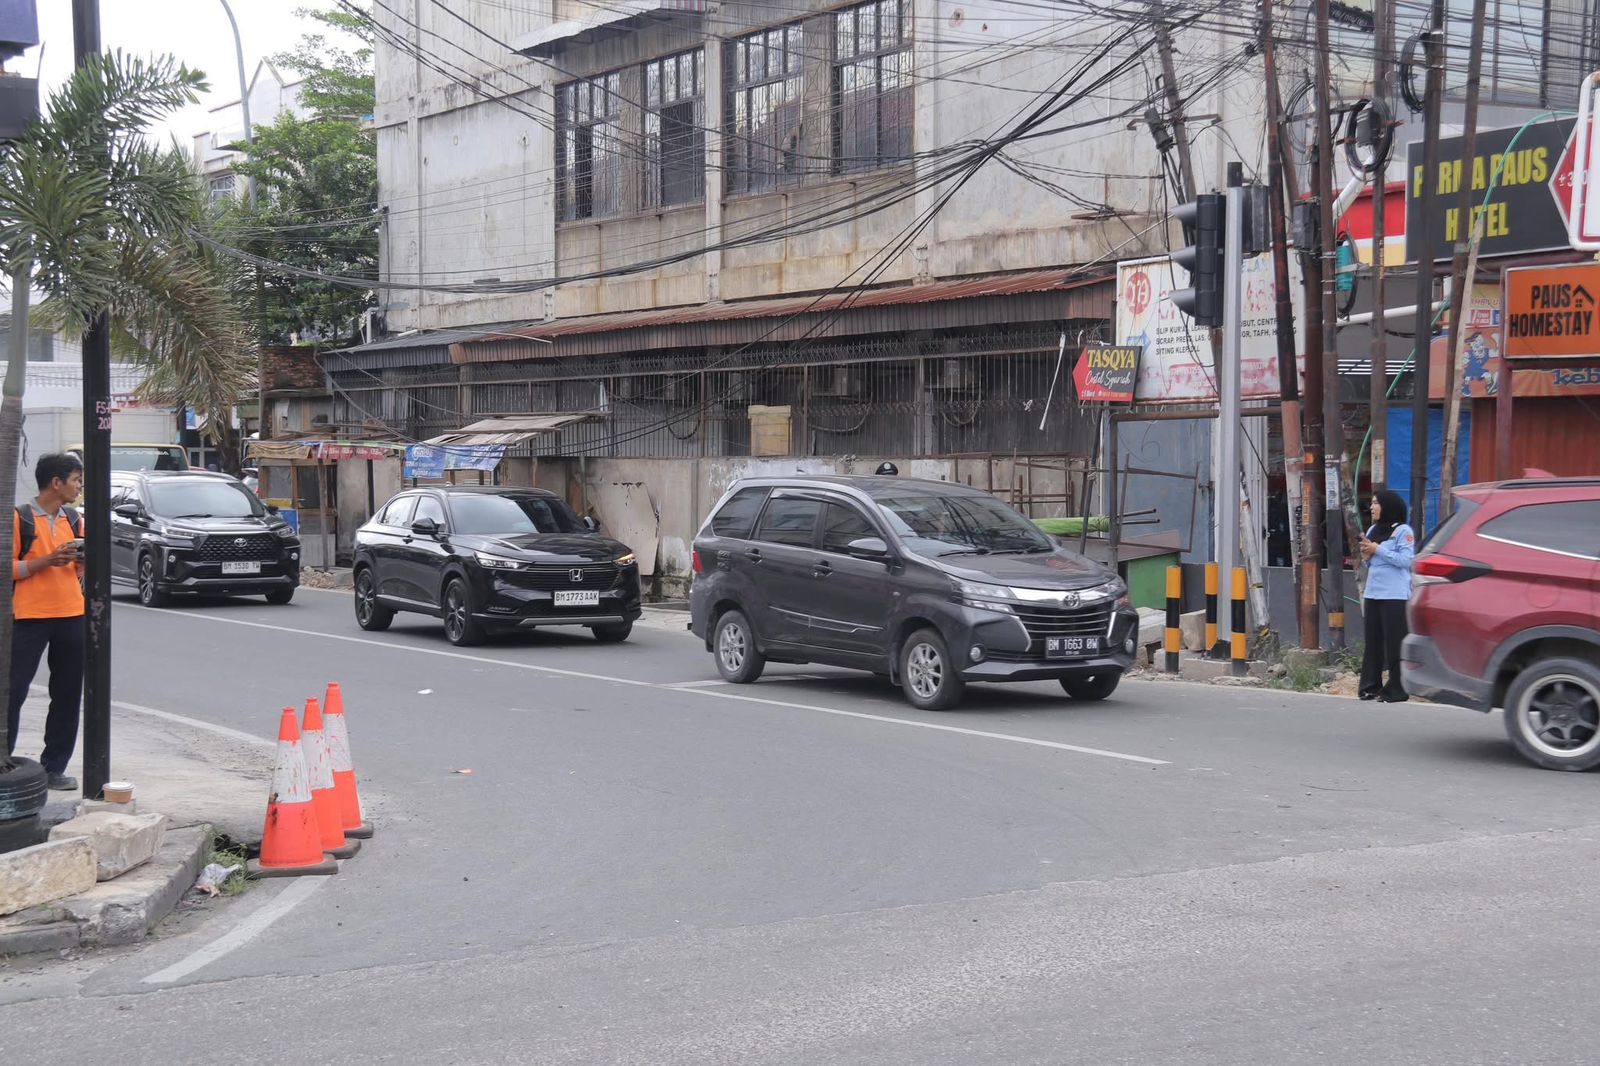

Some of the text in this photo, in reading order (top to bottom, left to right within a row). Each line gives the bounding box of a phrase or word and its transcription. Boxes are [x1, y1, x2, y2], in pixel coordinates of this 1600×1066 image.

[1490, 146, 1549, 188] PAUS
[1445, 201, 1510, 243] HTEL
[1531, 284, 1571, 309] PAUS
[1509, 311, 1593, 338] HOMESTAY
[1088, 349, 1135, 370] TASQYA
[1048, 639, 1059, 650] BM
[1064, 638, 1083, 650] 1663
